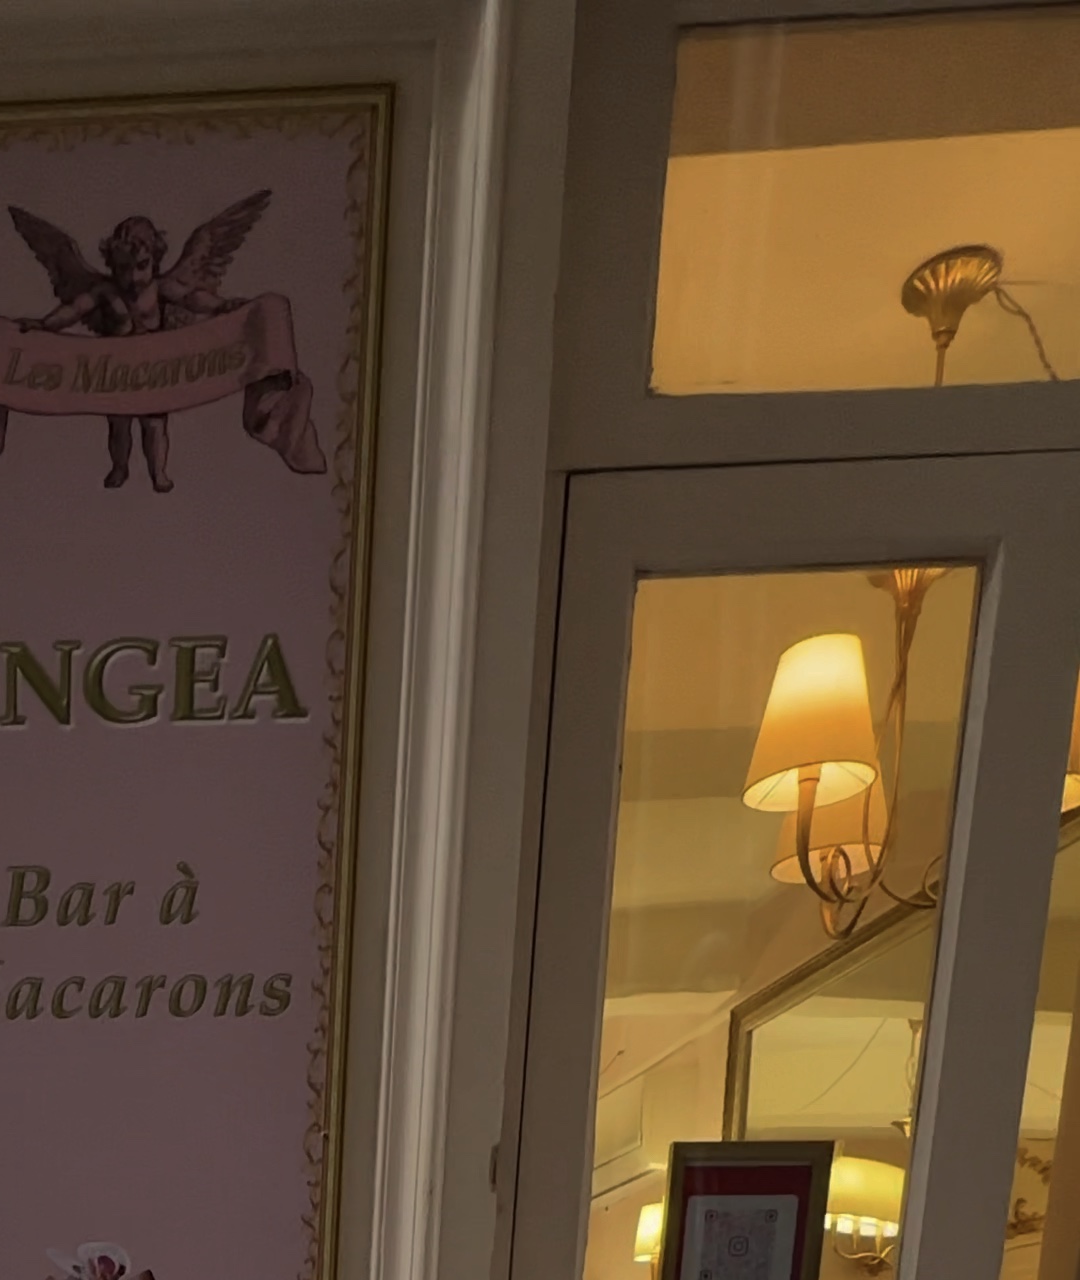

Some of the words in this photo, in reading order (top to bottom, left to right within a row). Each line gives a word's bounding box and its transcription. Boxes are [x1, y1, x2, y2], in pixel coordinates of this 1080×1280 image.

[2, 348, 64, 392] Les
[72, 347, 248, 395] Macarons
[0, 864, 136, 928] Bar
[158, 860, 201, 926] à
